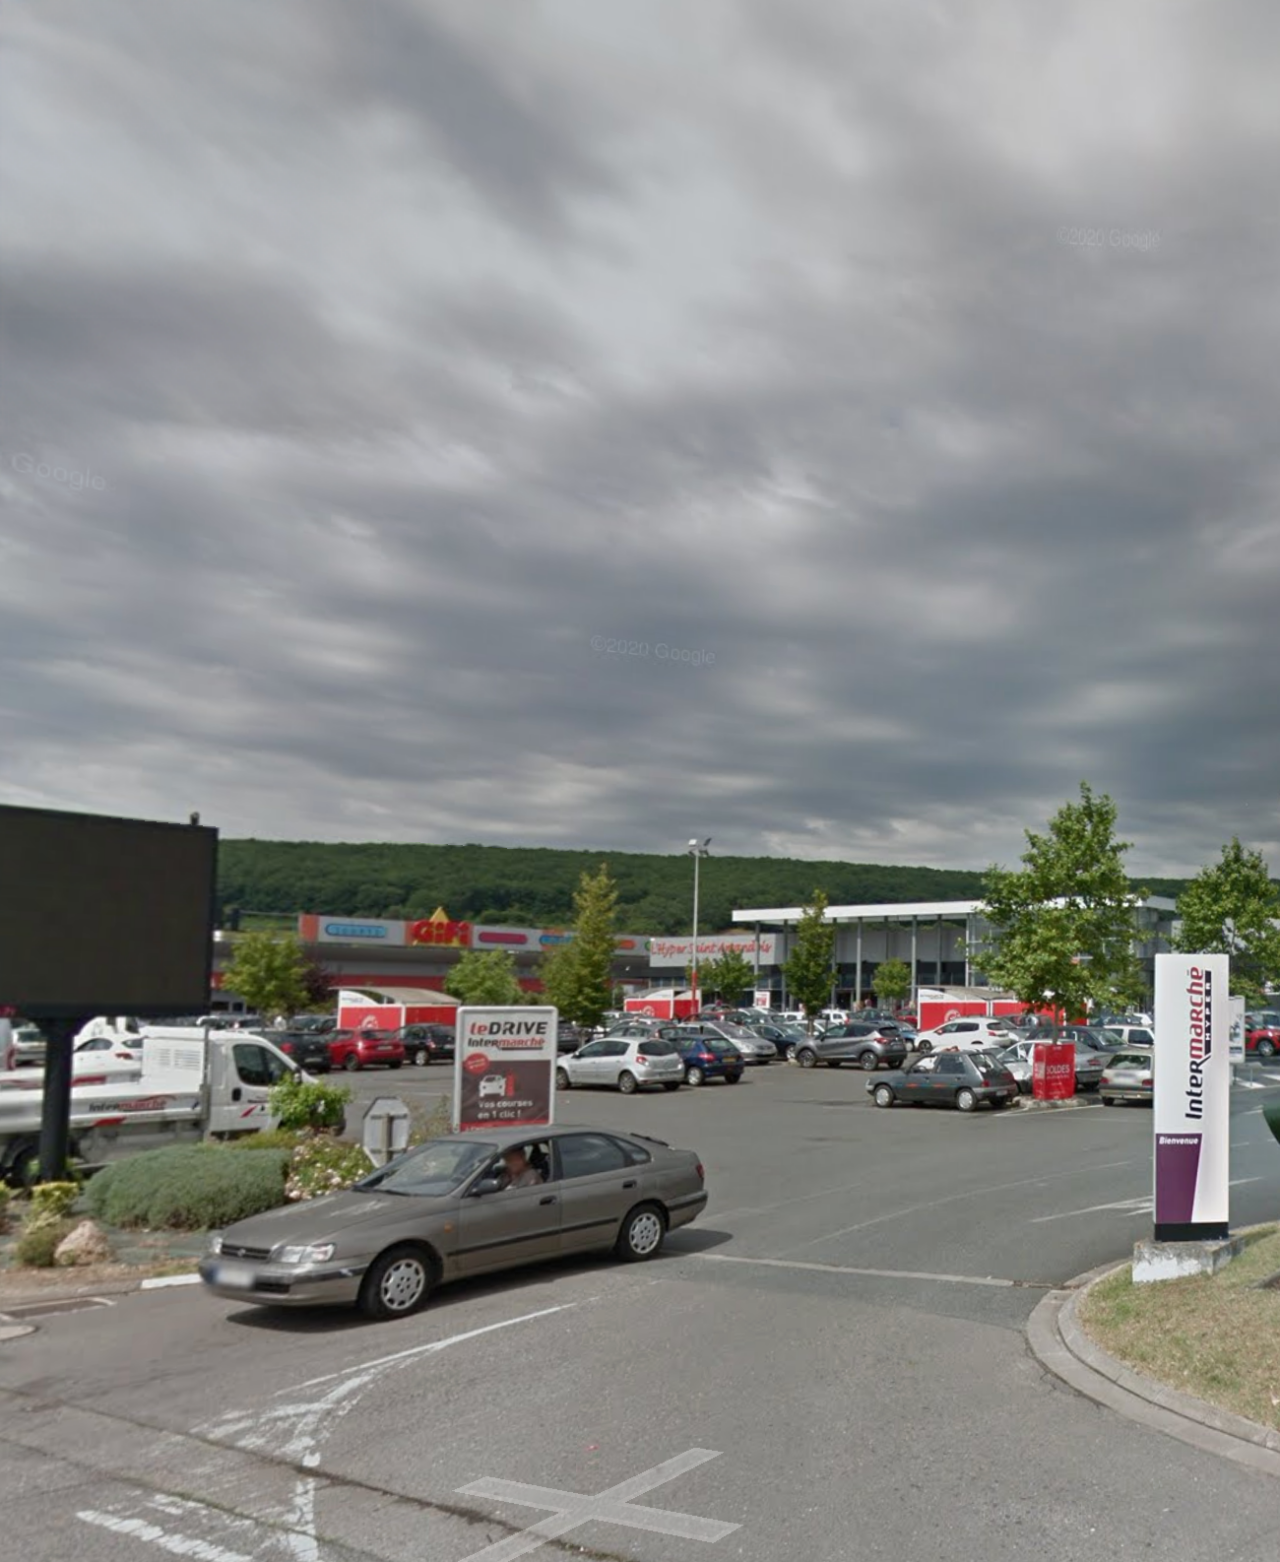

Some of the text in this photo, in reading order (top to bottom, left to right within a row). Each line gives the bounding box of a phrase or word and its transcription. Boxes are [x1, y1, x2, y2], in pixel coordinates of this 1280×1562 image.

[1204, 981, 1212, 1042] HYPER
[479, 1099, 533, 1108] Vos courses
[477, 1111, 490, 1119] en
[499, 1110, 515, 1118] clic
[1159, 1136, 1199, 1146] Bienvenue
